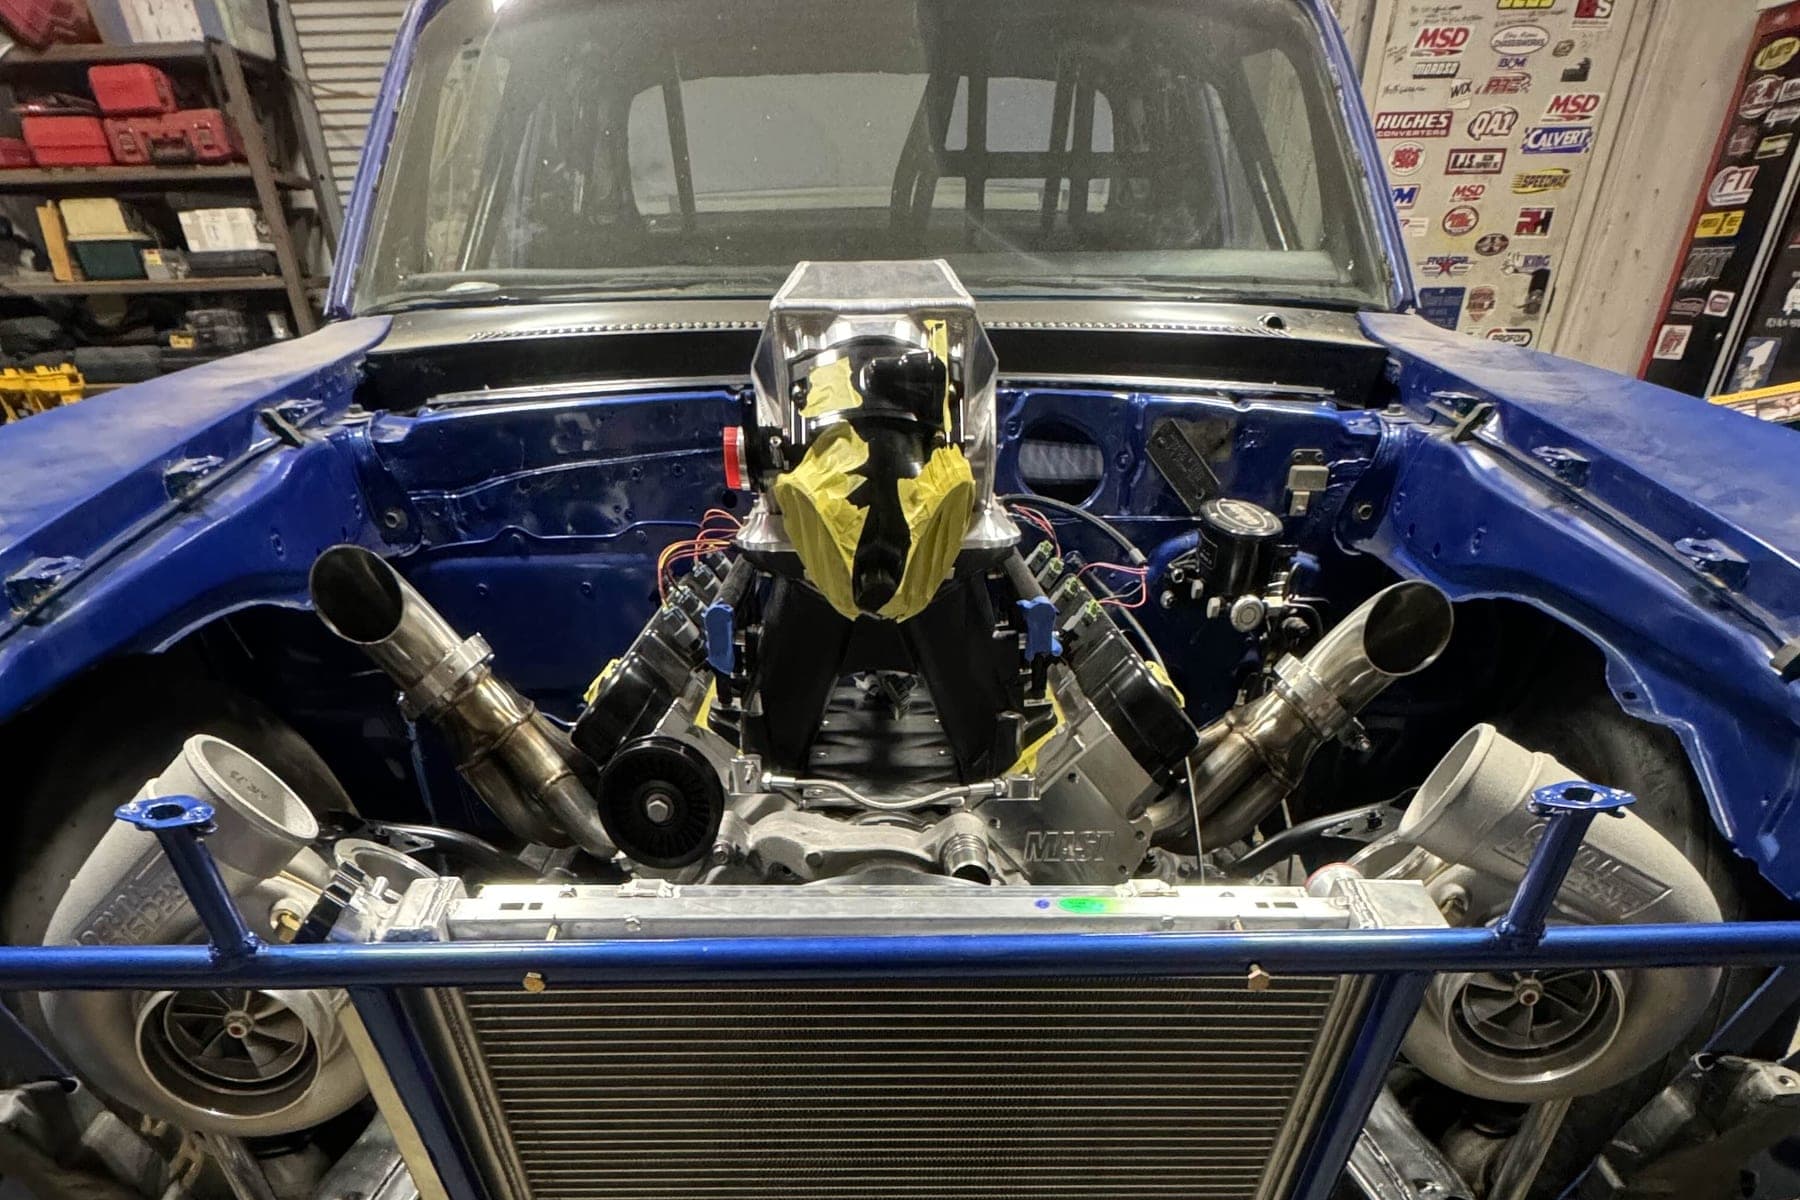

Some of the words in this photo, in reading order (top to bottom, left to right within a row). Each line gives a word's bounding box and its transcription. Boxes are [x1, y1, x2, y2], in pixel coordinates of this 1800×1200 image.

[1414, 27, 1470, 48] MSD
[1450, 81, 1472, 98] WIX
[1546, 94, 1600, 114] MSD
[1376, 113, 1449, 129] HUGHES
[1470, 110, 1514, 140] QA1
[1375, 130, 1447, 138] CONVERTERS
[1527, 128, 1588, 149] CALVERT
[1452, 184, 1486, 198] MSD
[1023, 830, 1116, 863] MAST
